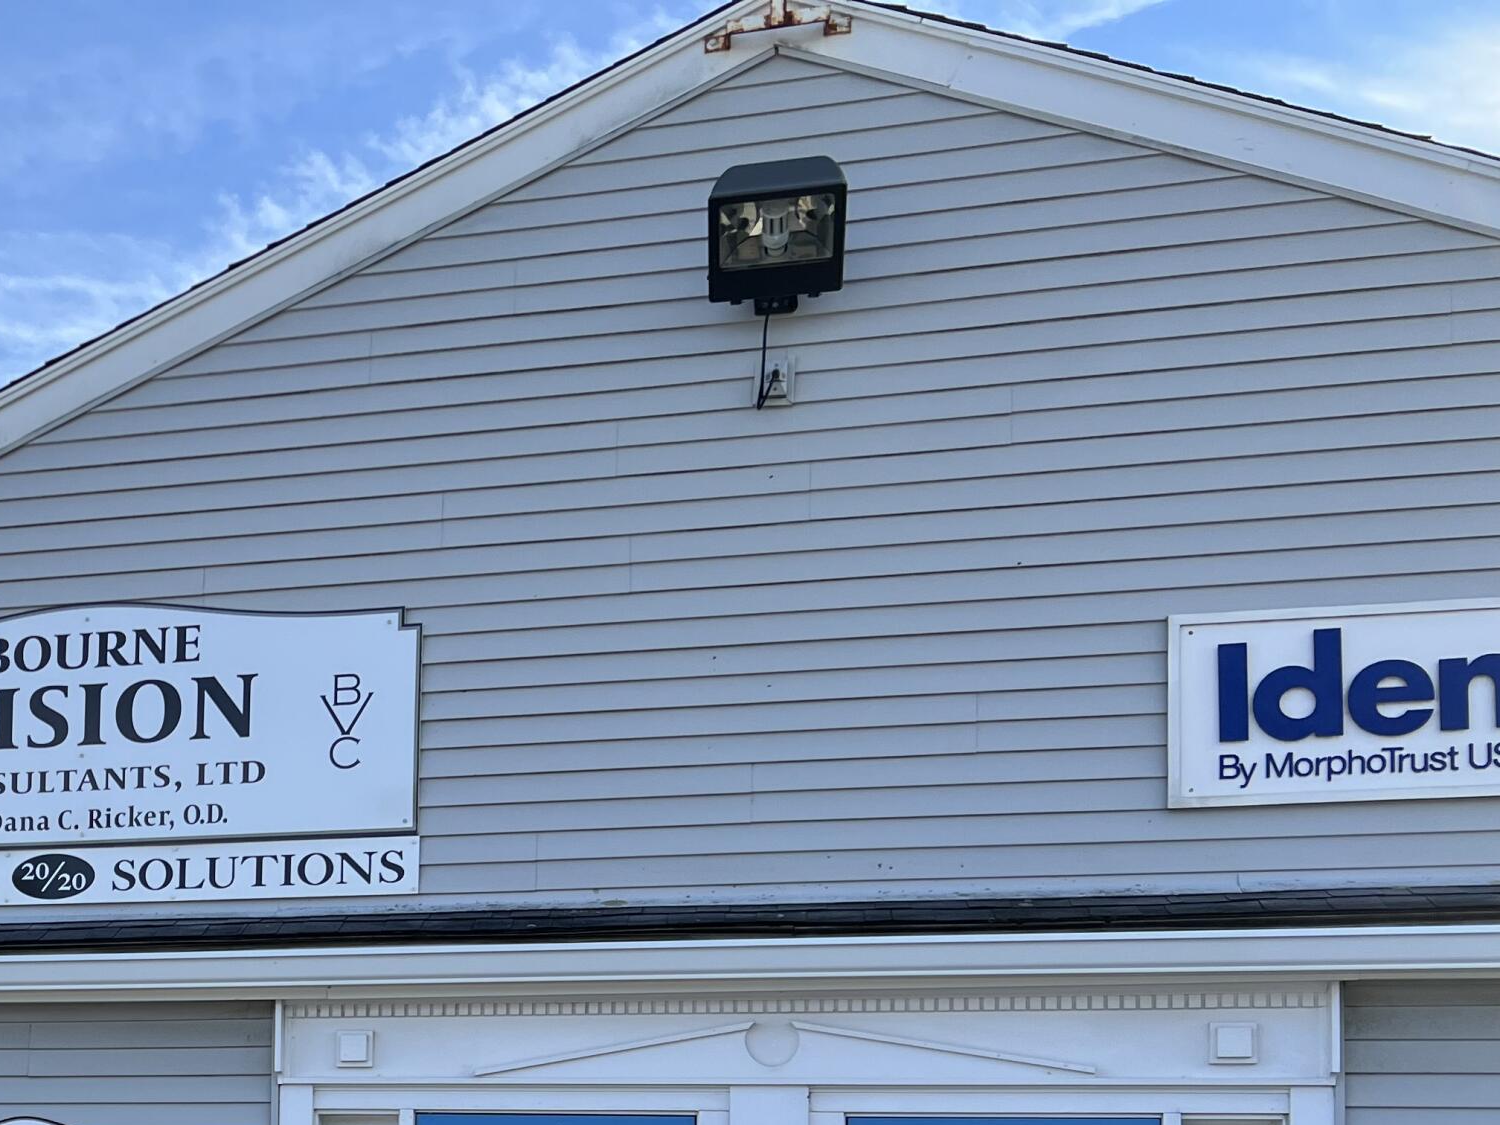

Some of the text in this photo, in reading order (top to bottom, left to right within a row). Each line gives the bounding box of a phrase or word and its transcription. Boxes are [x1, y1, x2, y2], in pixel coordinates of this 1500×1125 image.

[1217, 627, 1500, 743] Iden
[196, 760, 267, 787] LTD
[1218, 754, 1257, 788] By
[1265, 745, 1460, 782] MorphoTrust
[57, 808, 80, 831] C.
[87, 803, 175, 831] Ricker,
[183, 803, 228, 825] O.D.
[20, 861, 88, 893] 20/20
[111, 849, 406, 893] SOLUTIONS
